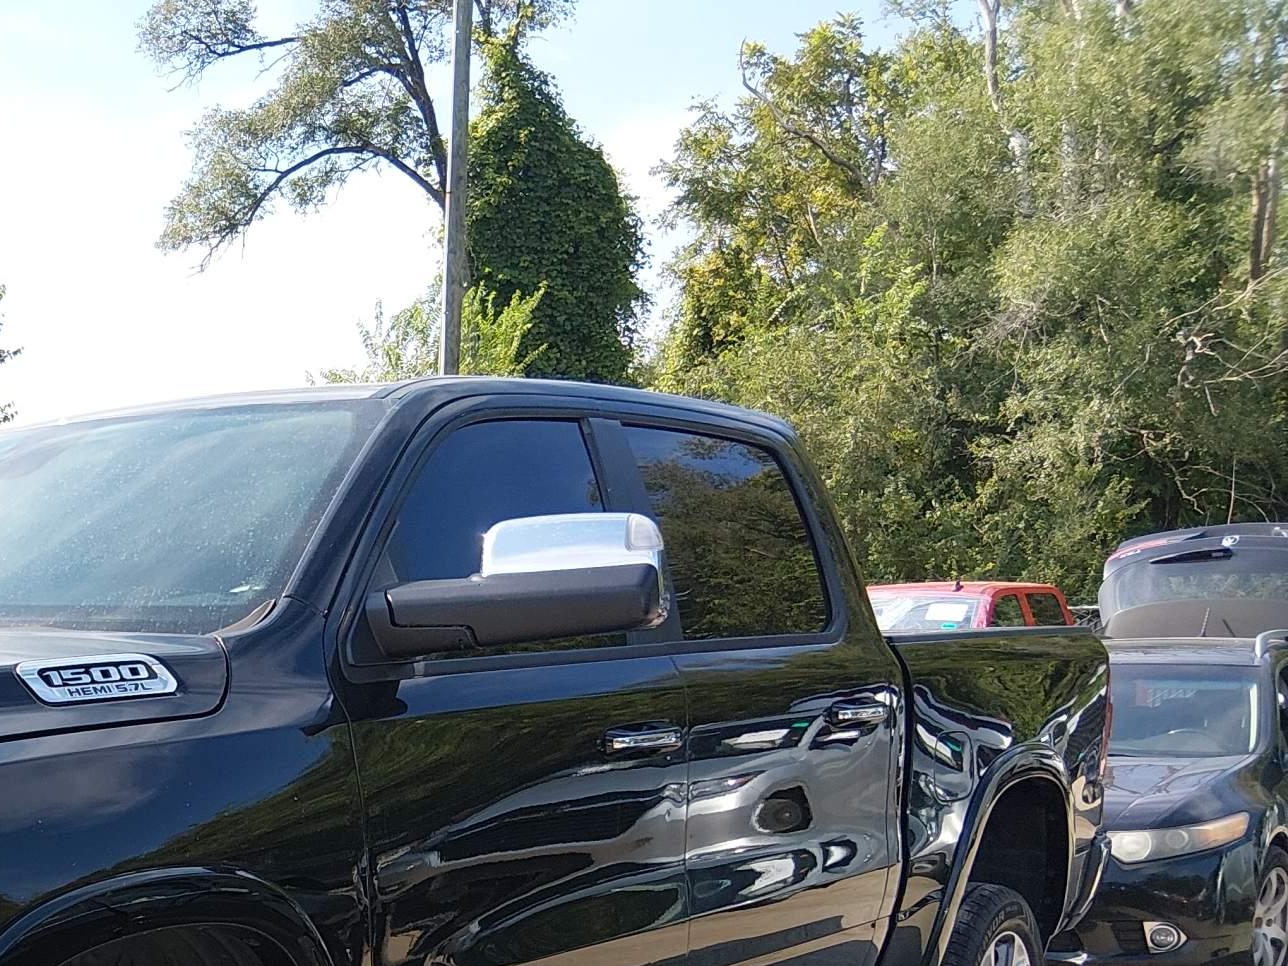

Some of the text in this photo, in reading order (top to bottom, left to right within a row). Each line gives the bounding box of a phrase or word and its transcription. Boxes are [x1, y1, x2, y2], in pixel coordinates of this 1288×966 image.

[42, 664, 150, 686] 1500
[68, 682, 152, 697] HEMI 5.7L
